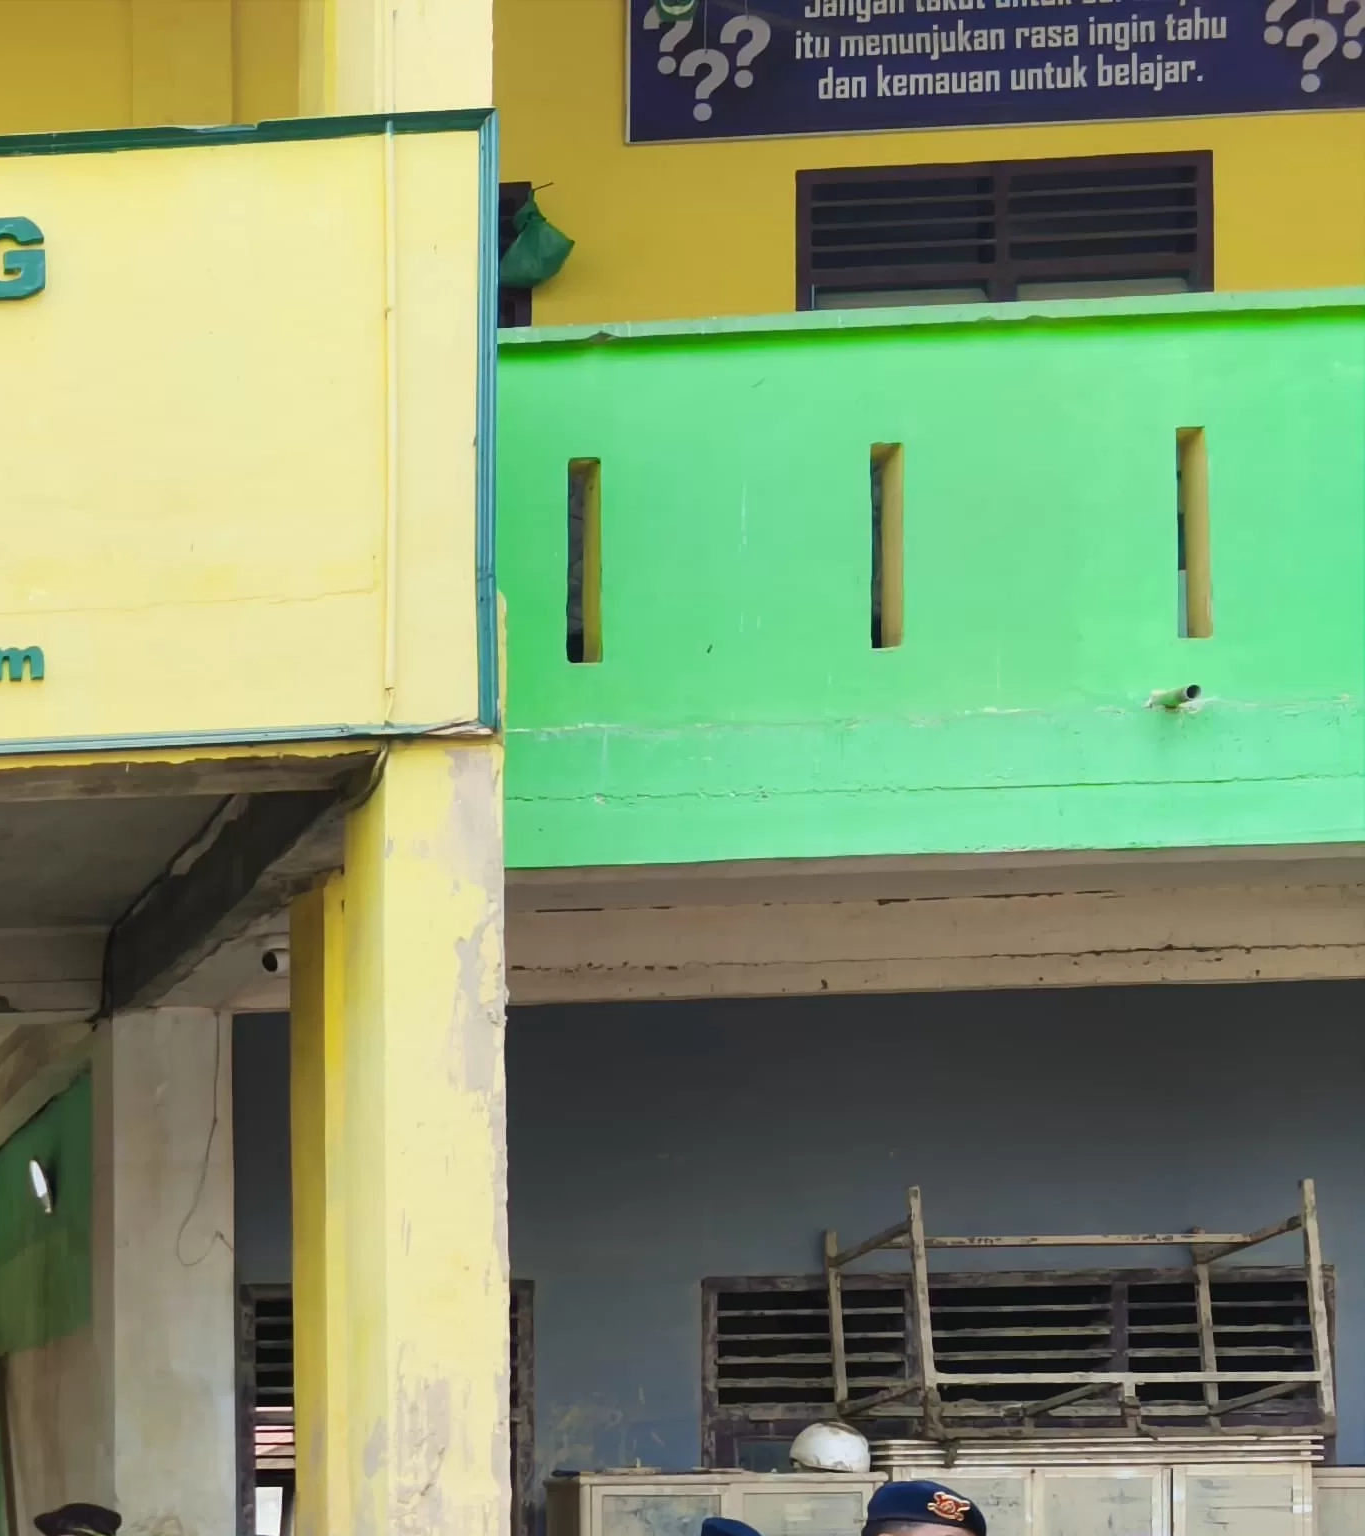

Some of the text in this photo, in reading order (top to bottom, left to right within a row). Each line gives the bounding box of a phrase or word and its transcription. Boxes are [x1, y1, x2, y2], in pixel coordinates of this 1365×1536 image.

[795, 7, 1227, 60] itu menunjukan rasa ingin tahu
[818, 53, 1205, 100] dan kemauan untuk belajar.
